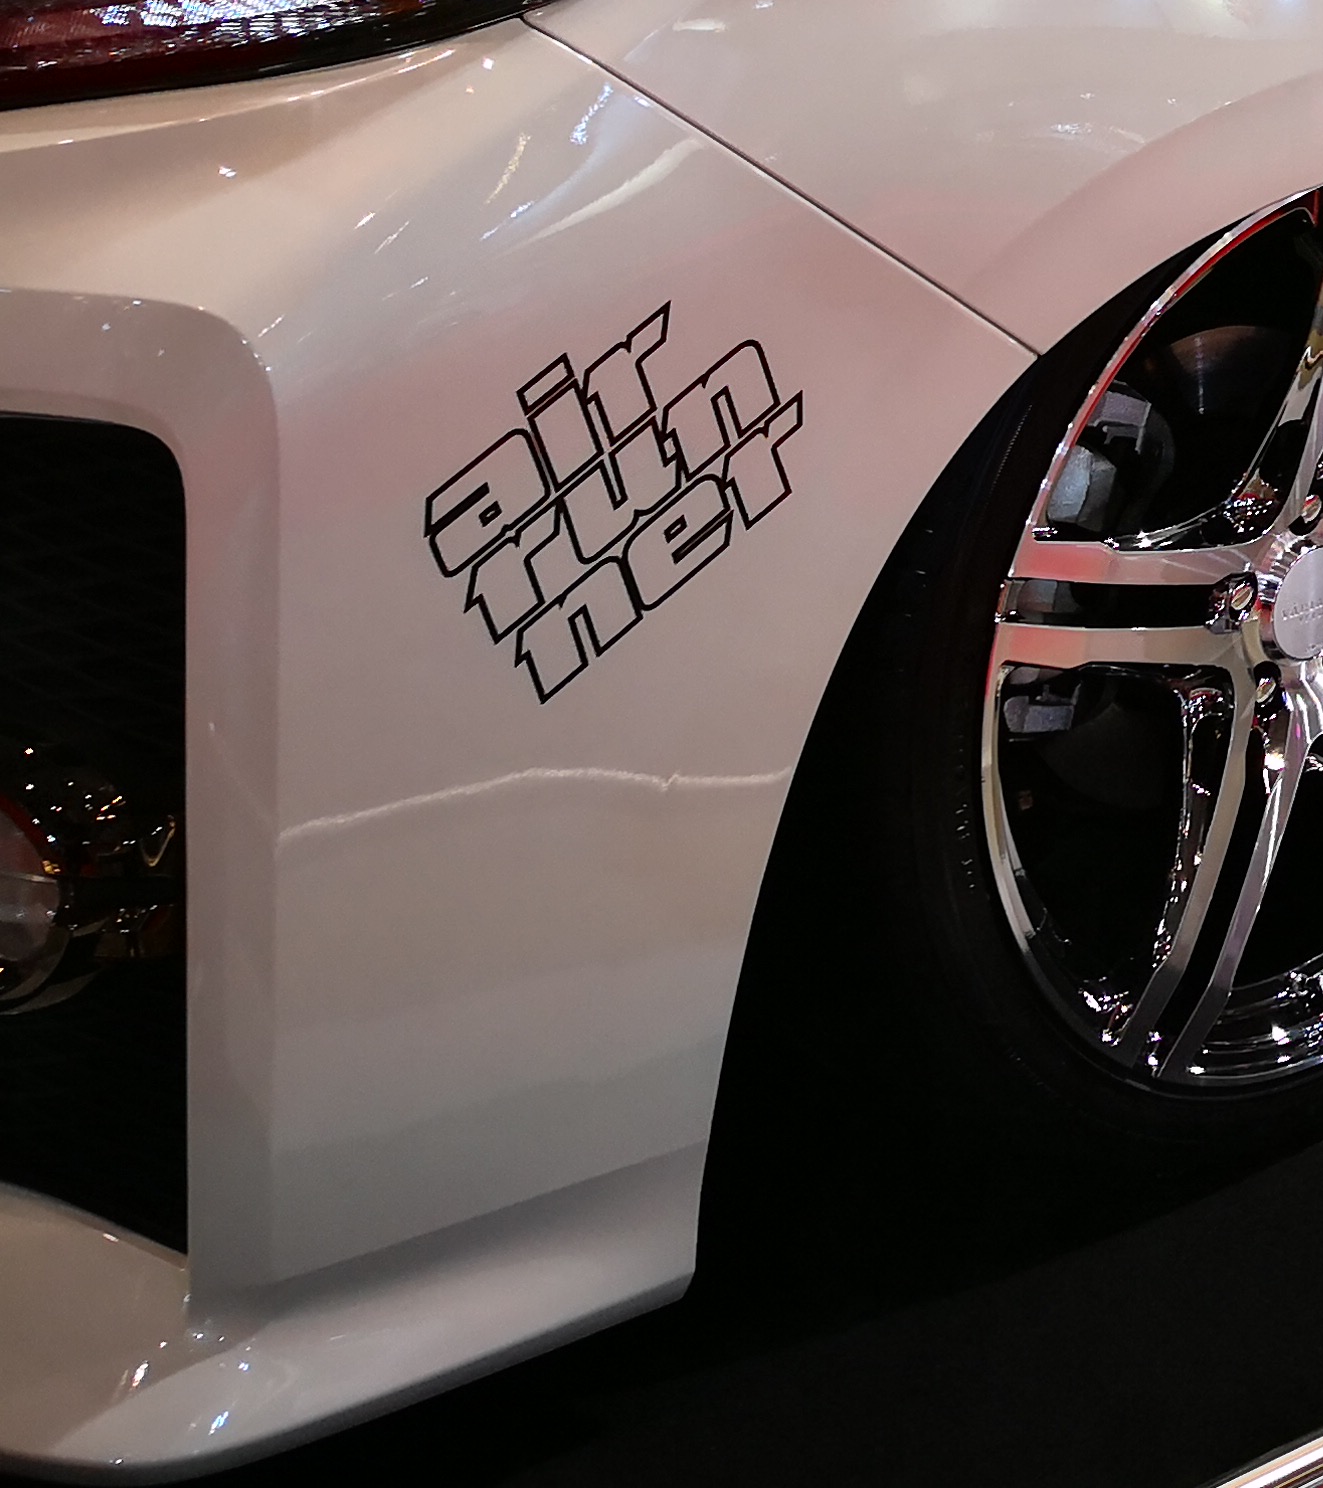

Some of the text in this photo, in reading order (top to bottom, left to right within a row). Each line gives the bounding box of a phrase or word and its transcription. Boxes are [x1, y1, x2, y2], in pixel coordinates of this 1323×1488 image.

[424, 300, 672, 577] air
[463, 338, 781, 645] run
[514, 389, 804, 705] ner
